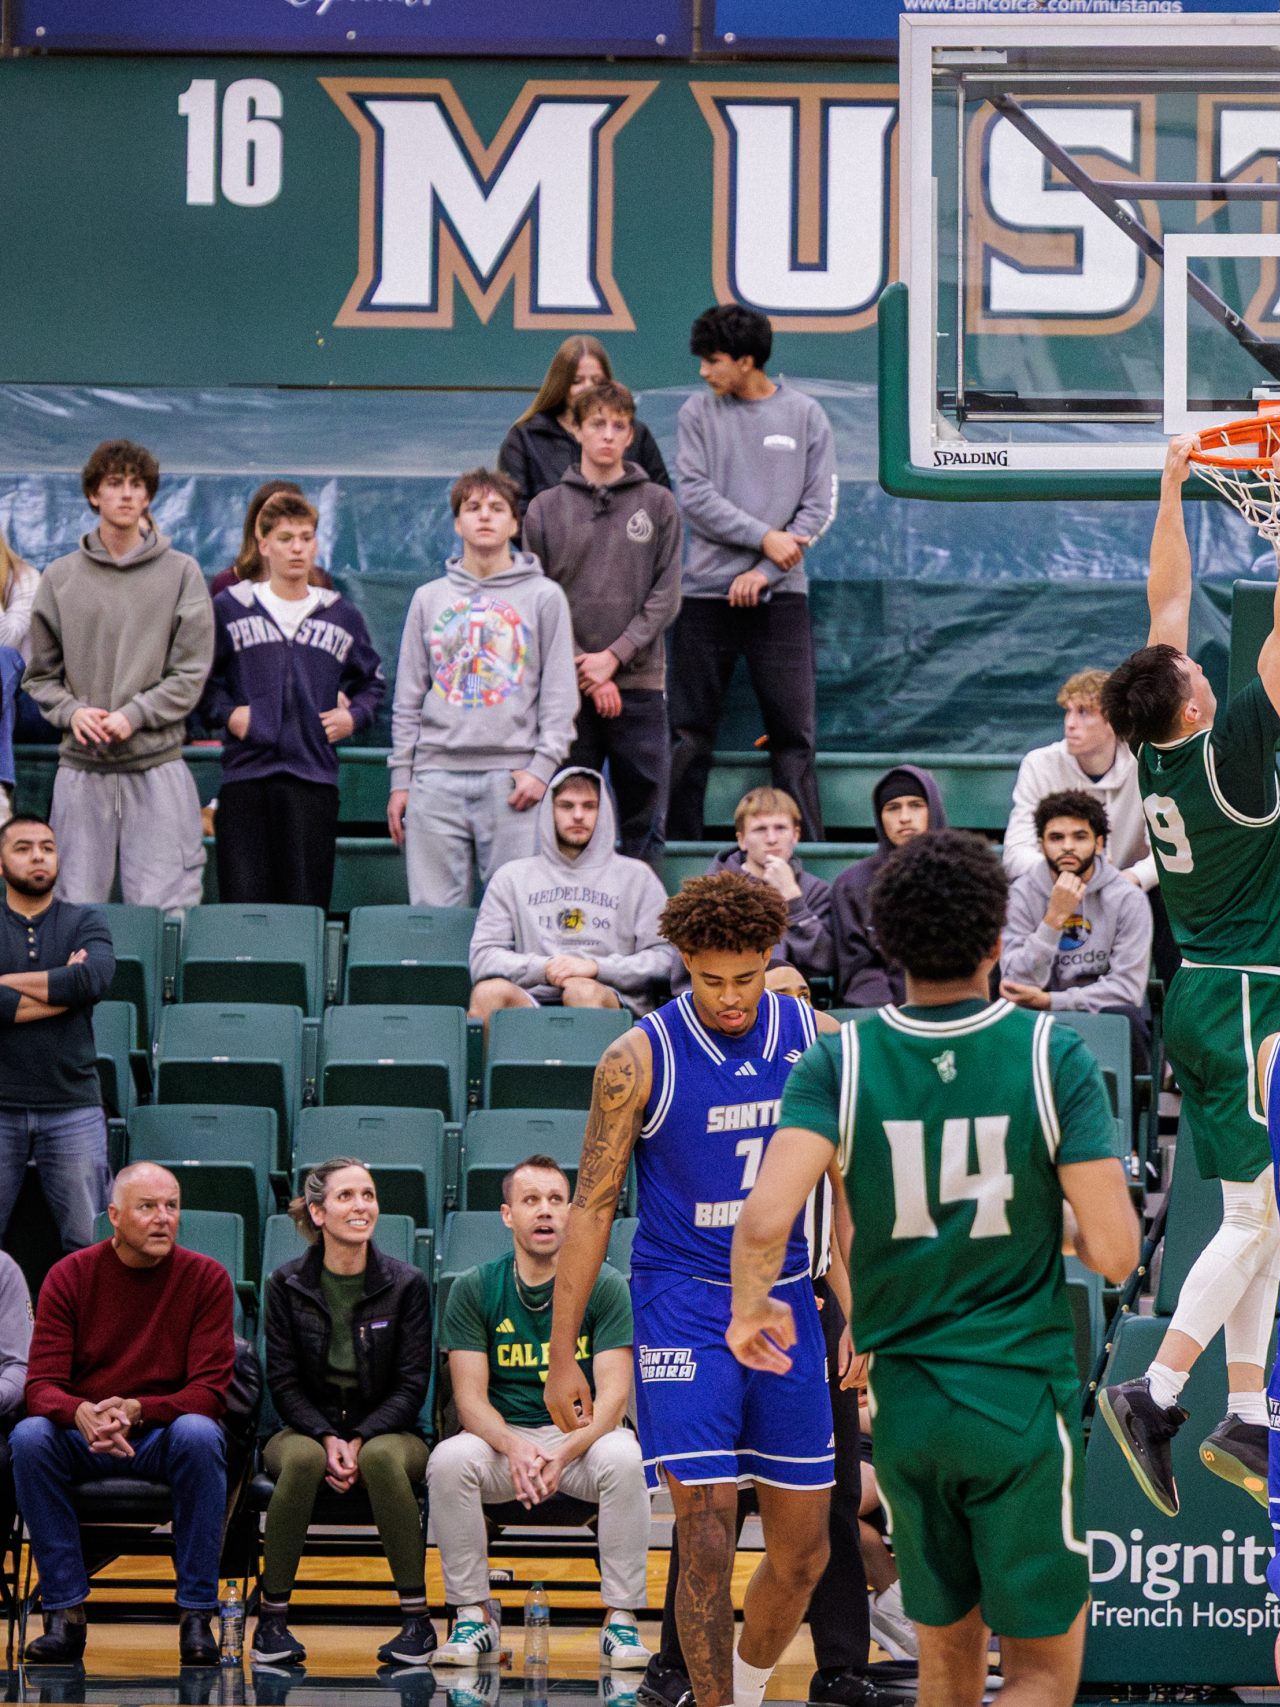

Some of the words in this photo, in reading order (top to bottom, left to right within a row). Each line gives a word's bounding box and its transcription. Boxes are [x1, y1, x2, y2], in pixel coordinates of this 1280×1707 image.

[177, 77, 284, 207] 16
[933, 450, 1008, 467] SPALDING
[1143, 792, 1195, 875] 9
[527, 886, 620, 910] HEIDELBERG
[706, 1099, 782, 1134] SANT
[882, 1115, 1014, 1239] 14
[496, 1343, 538, 1367] CAL
[1086, 1528, 1280, 1602] Dignit
[1091, 1600, 1183, 1627] French
